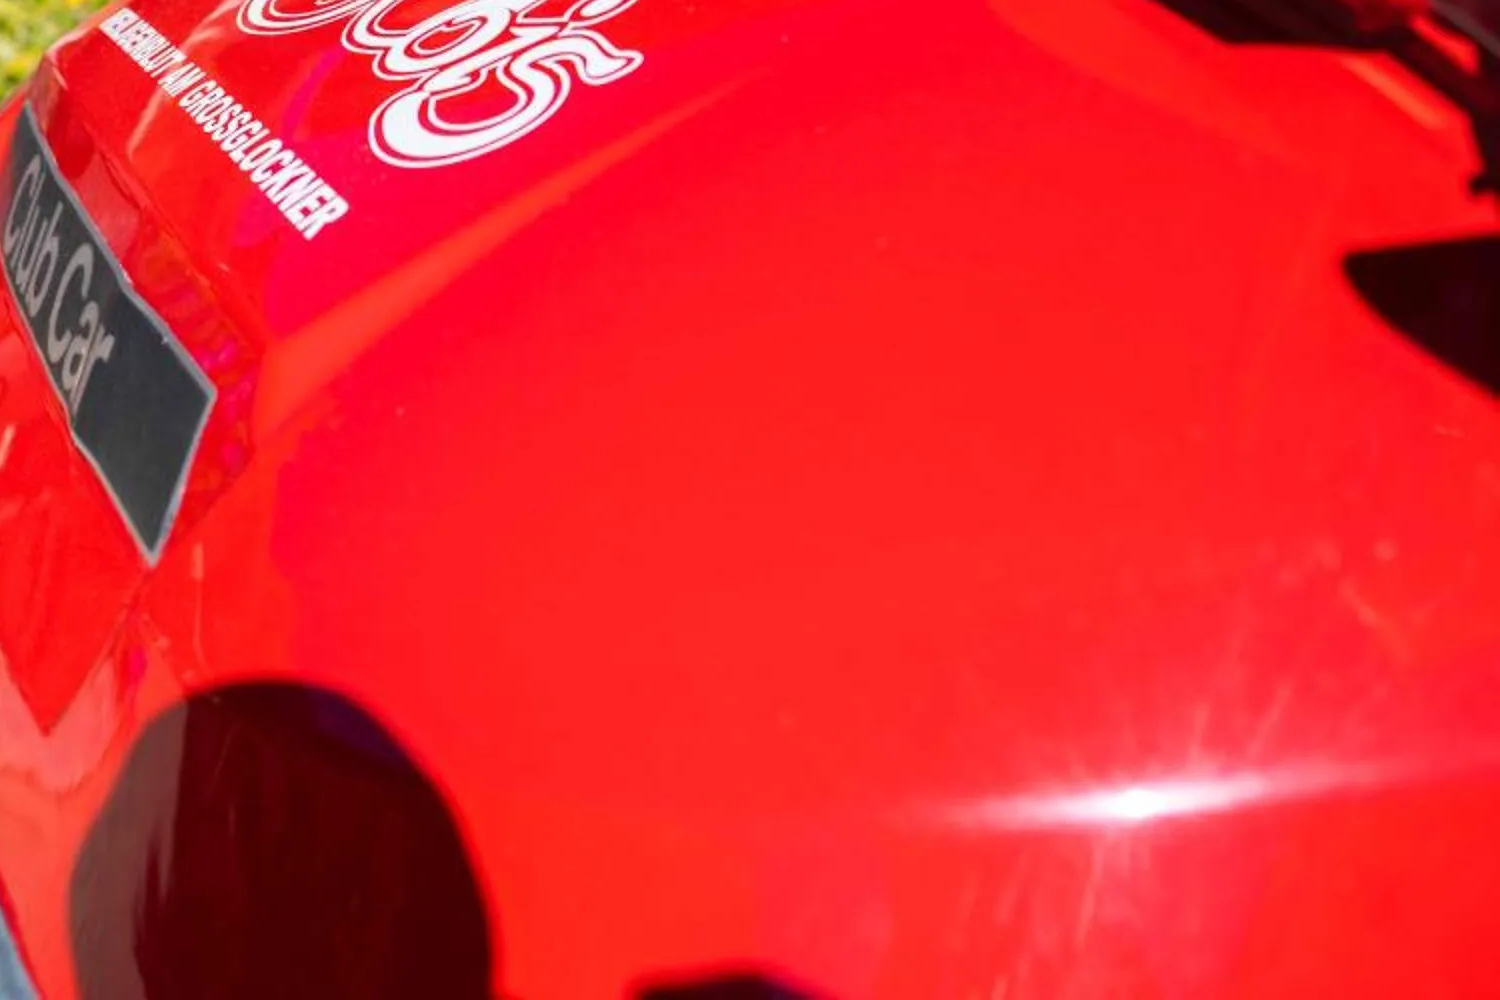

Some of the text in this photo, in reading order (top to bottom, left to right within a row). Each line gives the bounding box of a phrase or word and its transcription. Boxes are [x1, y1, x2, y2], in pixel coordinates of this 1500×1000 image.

[158, 62, 207, 97] AM
[178, 79, 349, 241] GROSSGLOCKNER
[3, 154, 116, 415] Club Car
